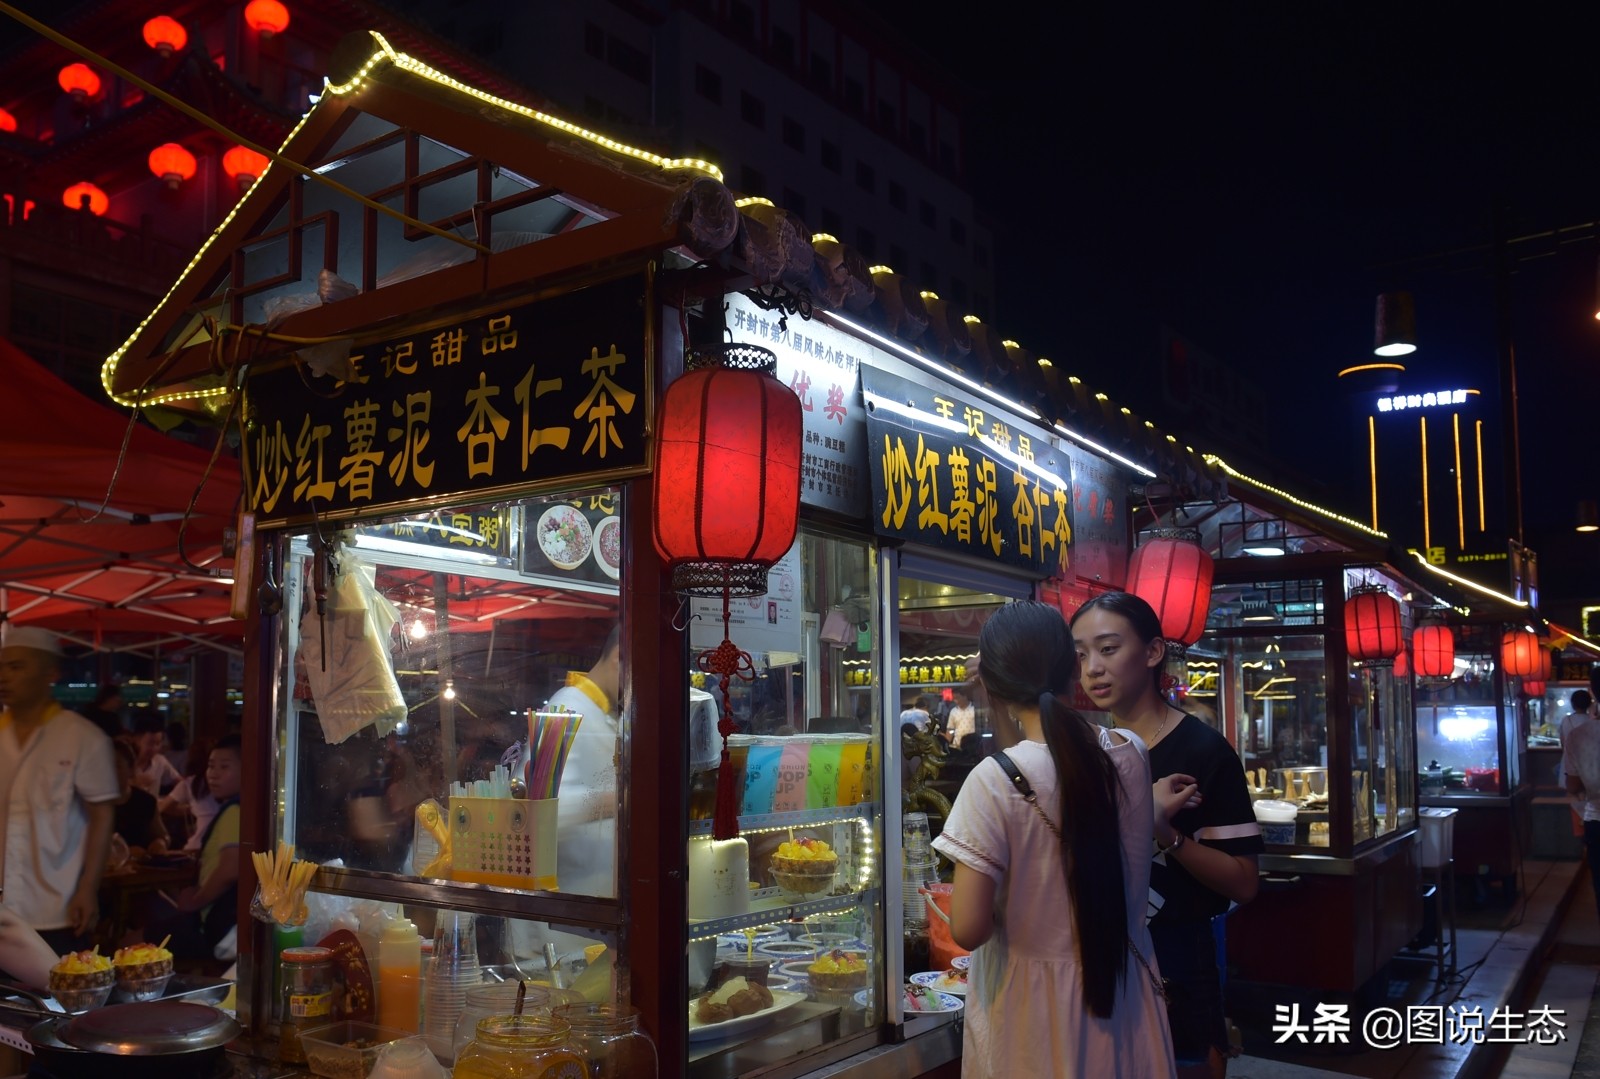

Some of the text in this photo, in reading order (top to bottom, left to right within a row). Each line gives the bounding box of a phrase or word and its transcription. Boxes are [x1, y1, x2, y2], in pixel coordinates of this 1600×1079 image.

[252, 343, 637, 514] 炒红薯泥 杏仁茶
[882, 433, 1072, 574] 炒红薯泥 杏仁茶
